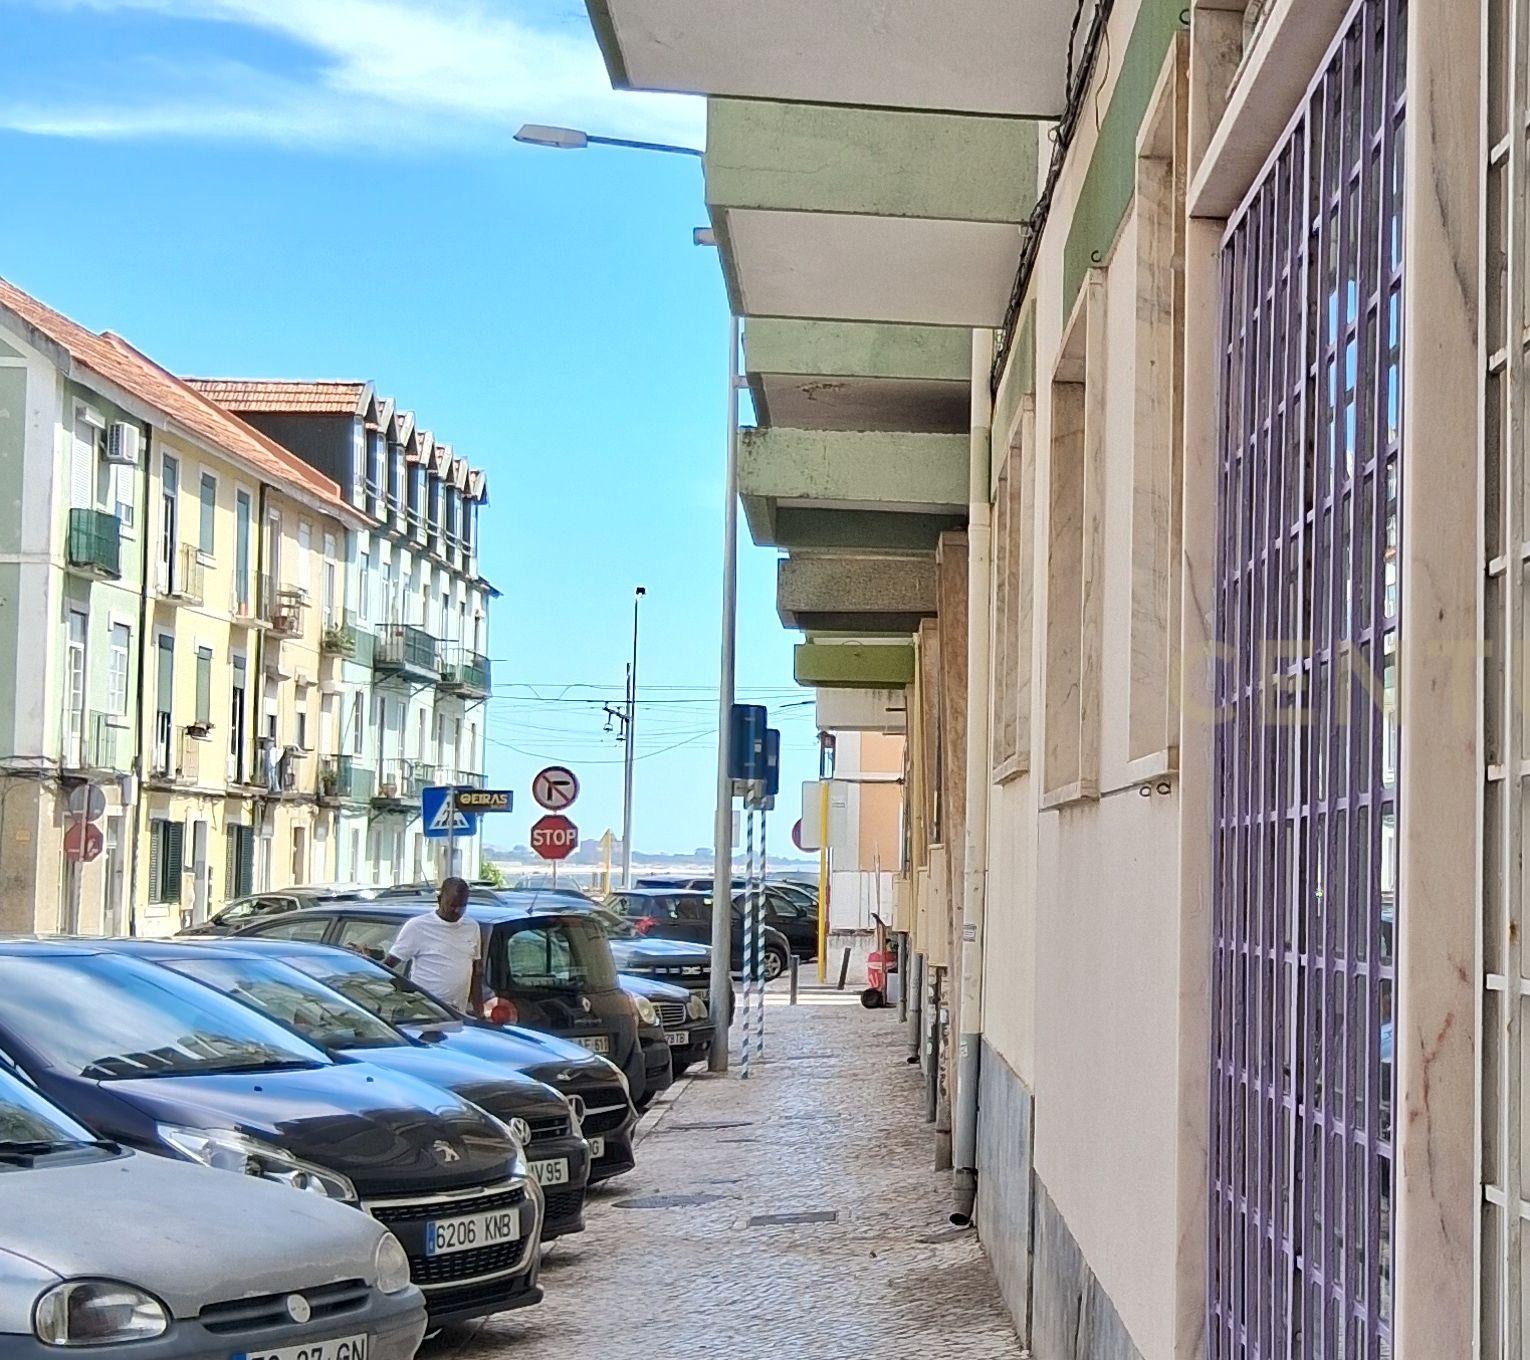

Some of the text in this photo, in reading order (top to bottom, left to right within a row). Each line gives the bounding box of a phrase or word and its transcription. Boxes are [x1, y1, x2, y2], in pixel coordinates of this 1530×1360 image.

[459, 792, 509, 805] OEIRAS
[532, 828, 577, 847] STOP
[545, 1161, 563, 1182] 95
[436, 1219, 476, 1250] 6206
[484, 1213, 511, 1241] KNB
